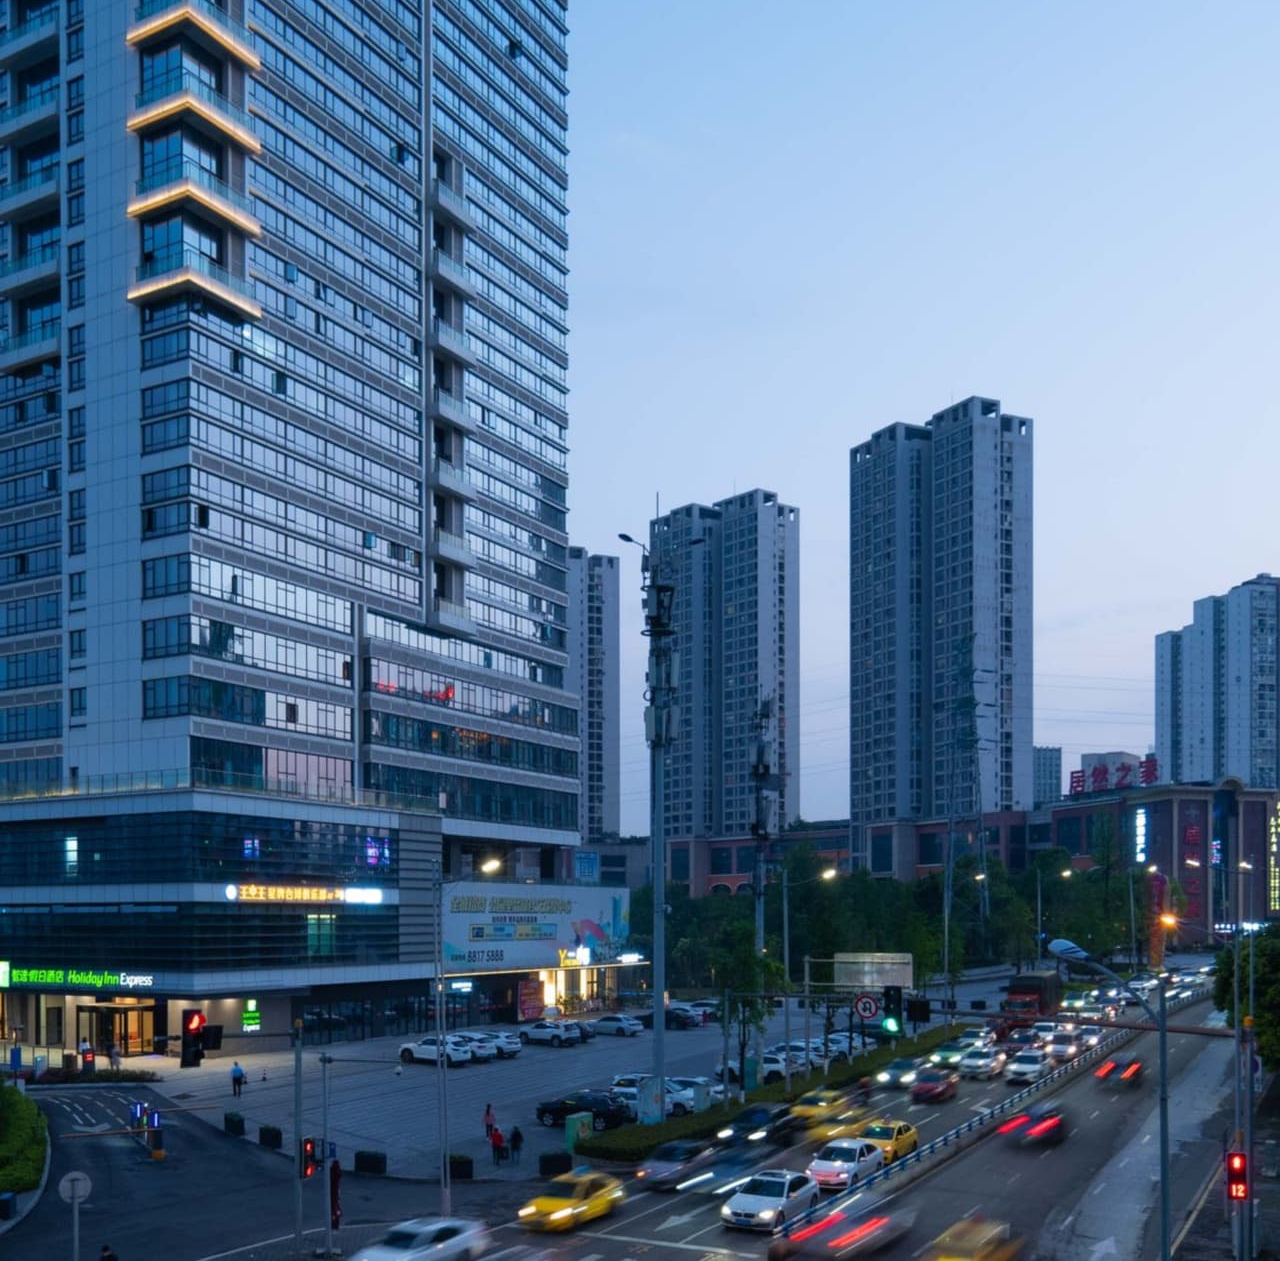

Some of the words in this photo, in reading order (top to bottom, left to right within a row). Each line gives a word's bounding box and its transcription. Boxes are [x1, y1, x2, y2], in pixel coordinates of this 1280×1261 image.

[68, 969, 104, 987] Holiday
[104, 970, 120, 985] Inn
[120, 972, 153, 988] Express
[1231, 1183, 1245, 1197] 12
